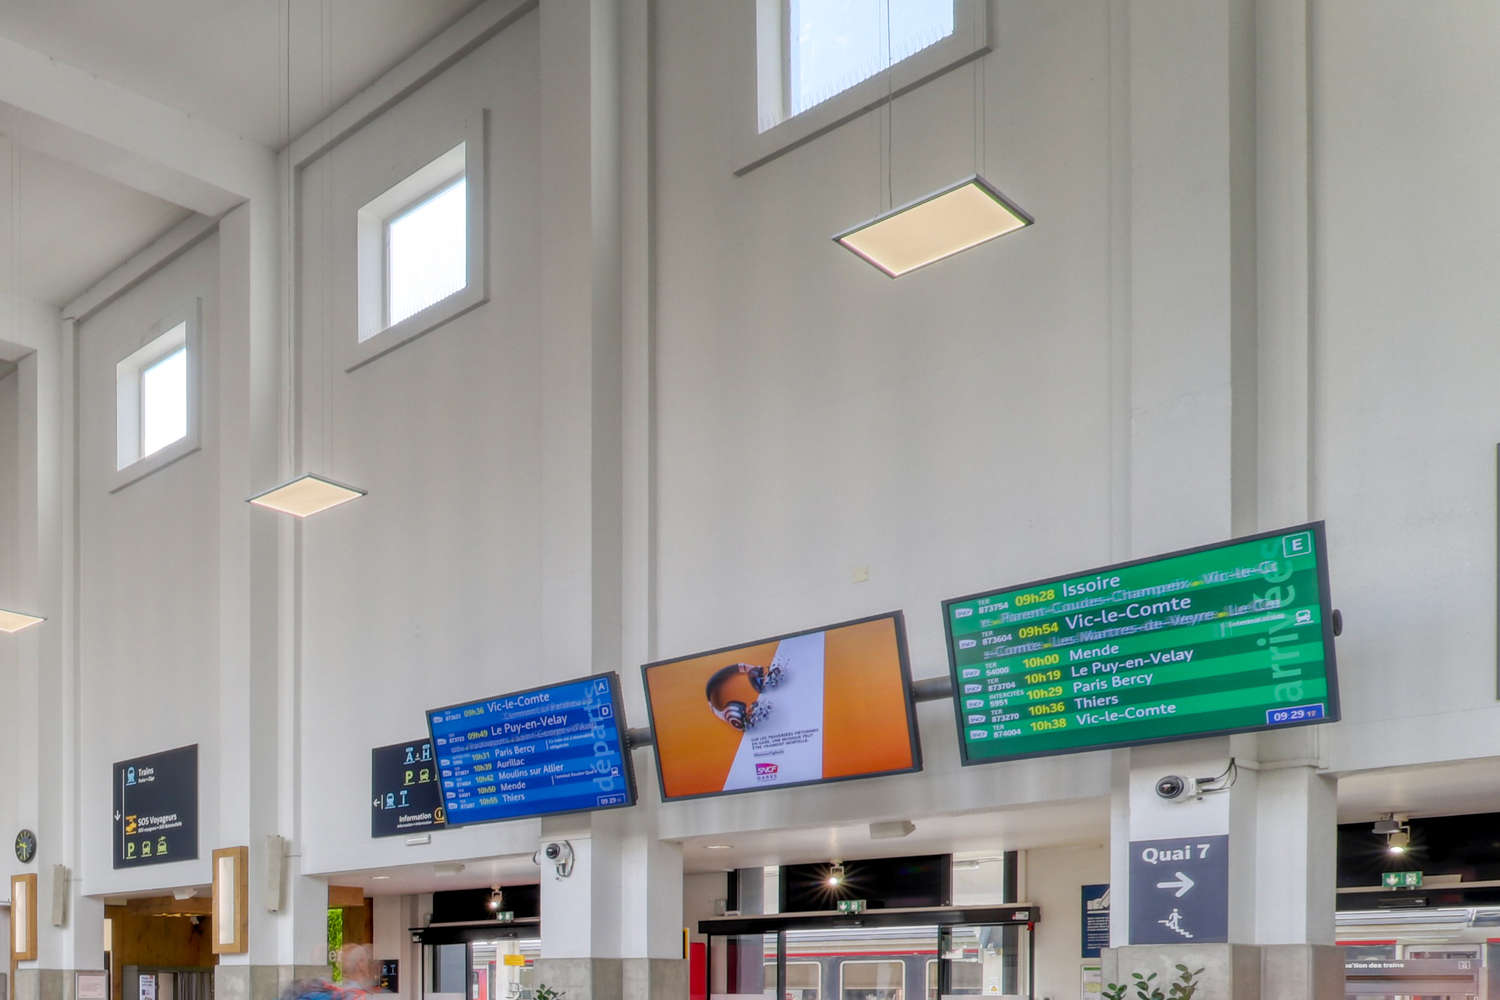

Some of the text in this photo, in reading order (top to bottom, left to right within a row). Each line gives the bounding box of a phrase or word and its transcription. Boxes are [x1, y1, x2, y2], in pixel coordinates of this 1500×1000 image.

[1291, 538, 1303, 552] E
[1015, 589, 1056, 607] 09h28
[1062, 576, 1121, 598] Issoire
[978, 602, 1009, 615] 873754
[1018, 621, 1059, 639] 09h54
[1065, 596, 1192, 630] Vic-le-Comte
[1022, 654, 1060, 669] 10h00
[1069, 643, 1120, 662] Mende
[986, 667, 1010, 677] 54000
[1024, 670, 1061, 684] 10h19
[1071, 665, 1088, 678] Le
[1092, 649, 1194, 675] Puy-en-Velay
[598, 682, 606, 691] A
[987, 682, 1016, 692] 873704
[1026, 686, 1063, 700] 10h29
[1073, 679, 1107, 694] Paris
[1111, 673, 1153, 688] Bercy
[464, 707, 485, 717] 09h36
[487, 692, 550, 713] Vic-le-Comte
[989, 699, 1008, 708] 5951
[1028, 702, 1065, 716] 10h36
[1074, 694, 1119, 710] Thiers
[601, 707, 609, 715] D
[1030, 718, 1067, 732] 10h38
[1076, 703, 1177, 726] Vic-le-Comte
[467, 730, 488, 740] 09h49
[491, 725, 502, 736] Le
[504, 714, 568, 735] Puy-en-Velay
[993, 728, 1022, 738] 874004
[406, 748, 430, 763] A H
[471, 752, 490, 761] 10h31
[495, 747, 513, 757] Paris
[514, 744, 536, 754] Bercy
[138, 767, 154, 777] Trains
[473, 763, 492, 772] 10h39
[497, 758, 525, 768] Aurillac
[757, 765, 778, 775] SNCF
[475, 774, 494, 784] 10h42
[498, 770, 529, 780] Moulins
[531, 768, 541, 776] sur
[543, 763, 564, 774] Allier
[477, 786, 496, 795] 10h50
[500, 781, 526, 791] Mende
[479, 796, 498, 806] 10h55
[502, 793, 525, 803] Thiers
[137, 813, 177, 826] SOS Voyageurs
[398, 812, 432, 823] Information
[1142, 843, 1210, 865] Quai 7
